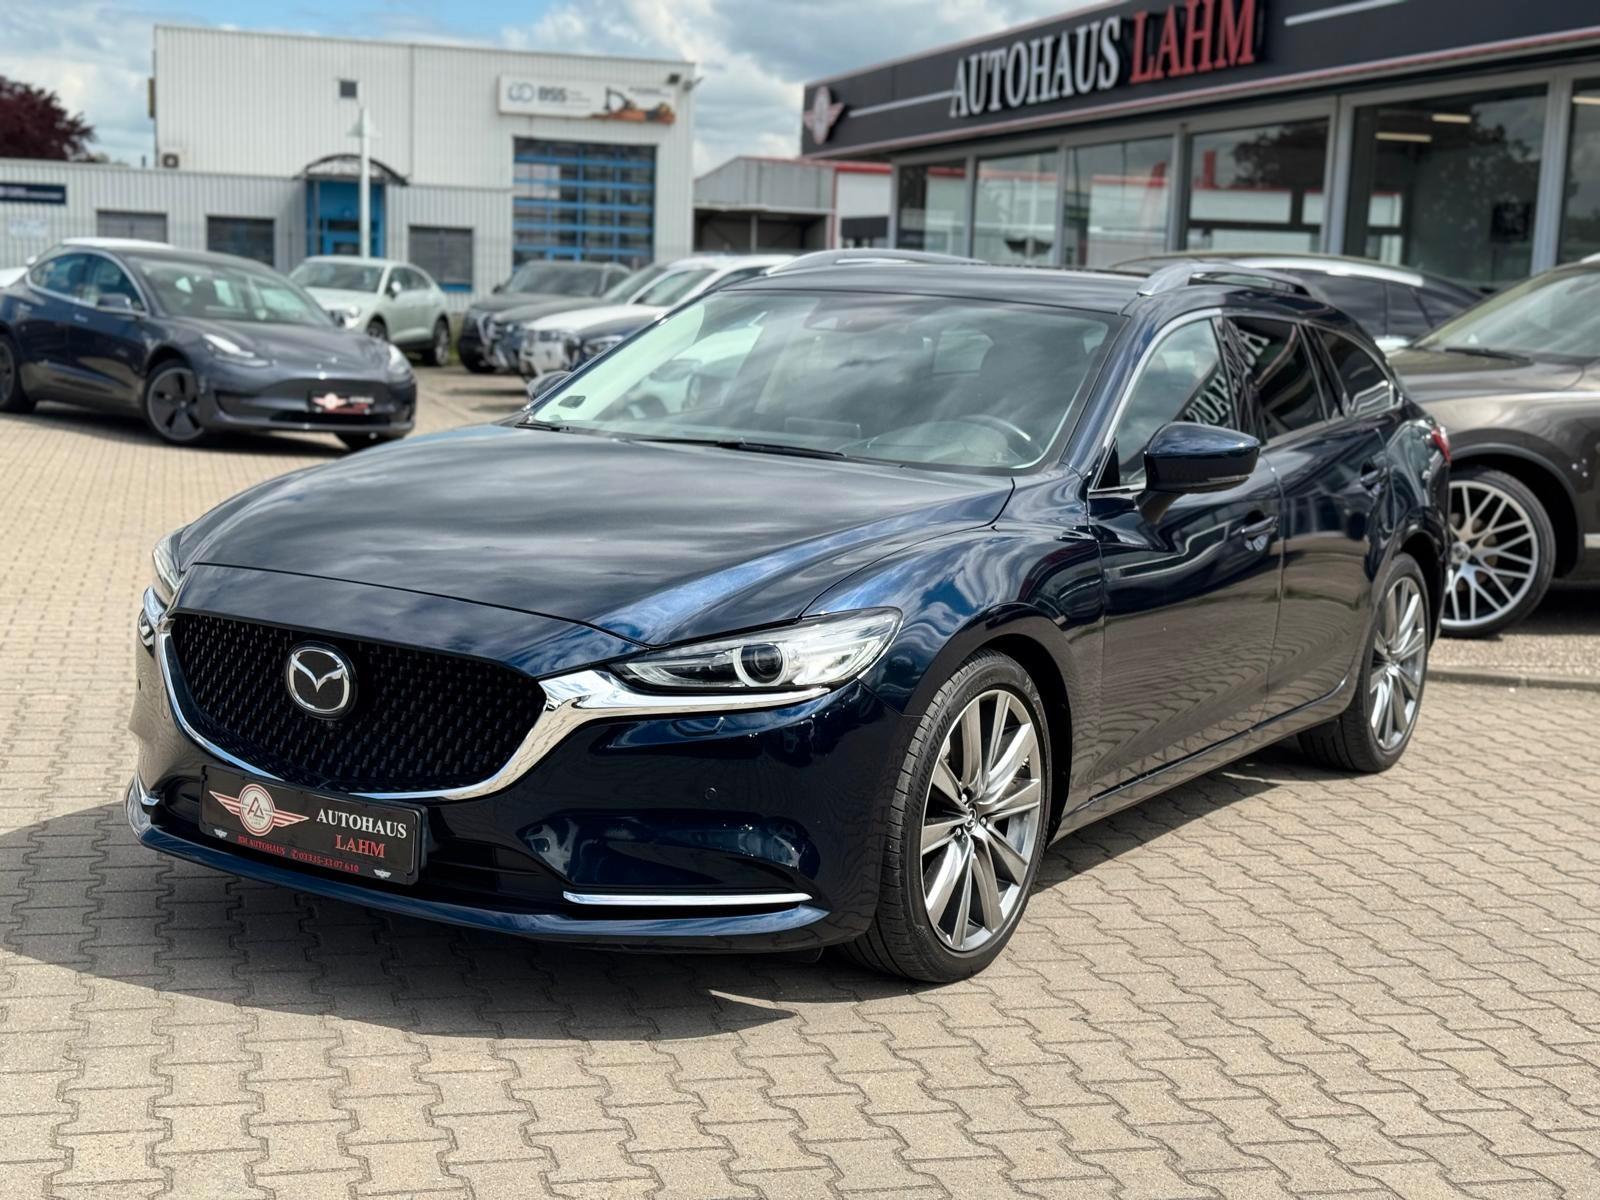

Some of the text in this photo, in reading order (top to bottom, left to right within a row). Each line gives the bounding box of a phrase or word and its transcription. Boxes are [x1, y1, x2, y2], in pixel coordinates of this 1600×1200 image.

[949, 0, 1257, 118] AUTOHAUS LAHM
[316, 807, 408, 839] AUTOHAUS
[249, 838, 286, 857] AUTOHAUS
[335, 833, 386, 859] LAHM
